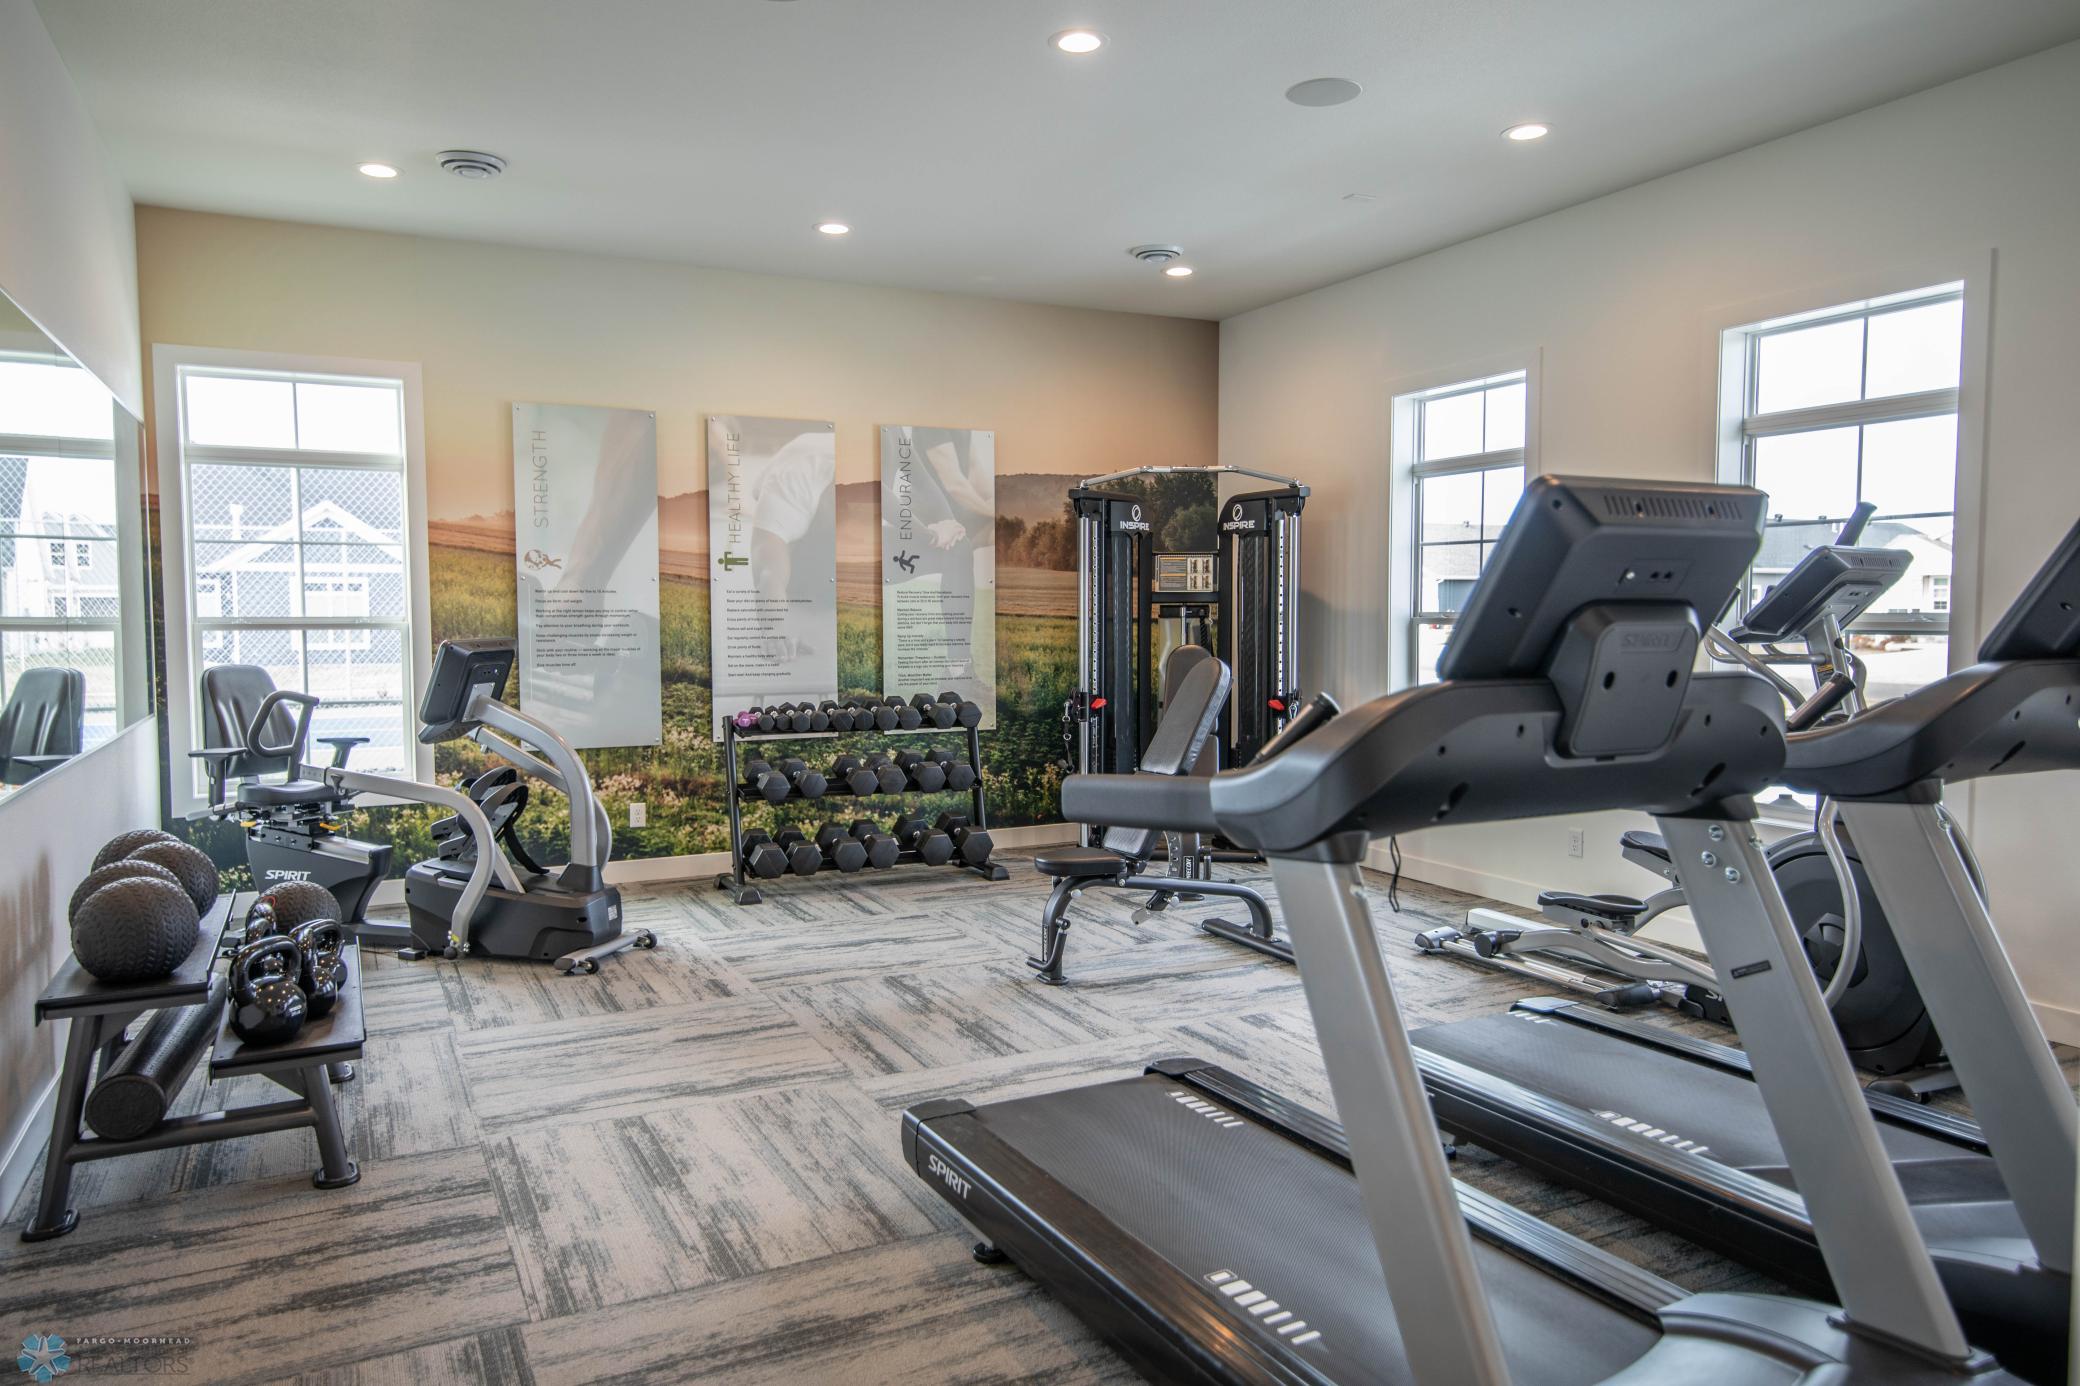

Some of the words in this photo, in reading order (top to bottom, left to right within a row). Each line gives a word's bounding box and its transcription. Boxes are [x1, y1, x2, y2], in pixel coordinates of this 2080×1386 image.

[531, 430, 549, 528] STRENGTH
[726, 432, 741, 466] LIFE
[727, 471, 742, 544] HEALTHY
[899, 438, 913, 540] ENDURANCE
[264, 869, 311, 881] SPIRIT
[927, 1153, 972, 1200] SPIRIT
